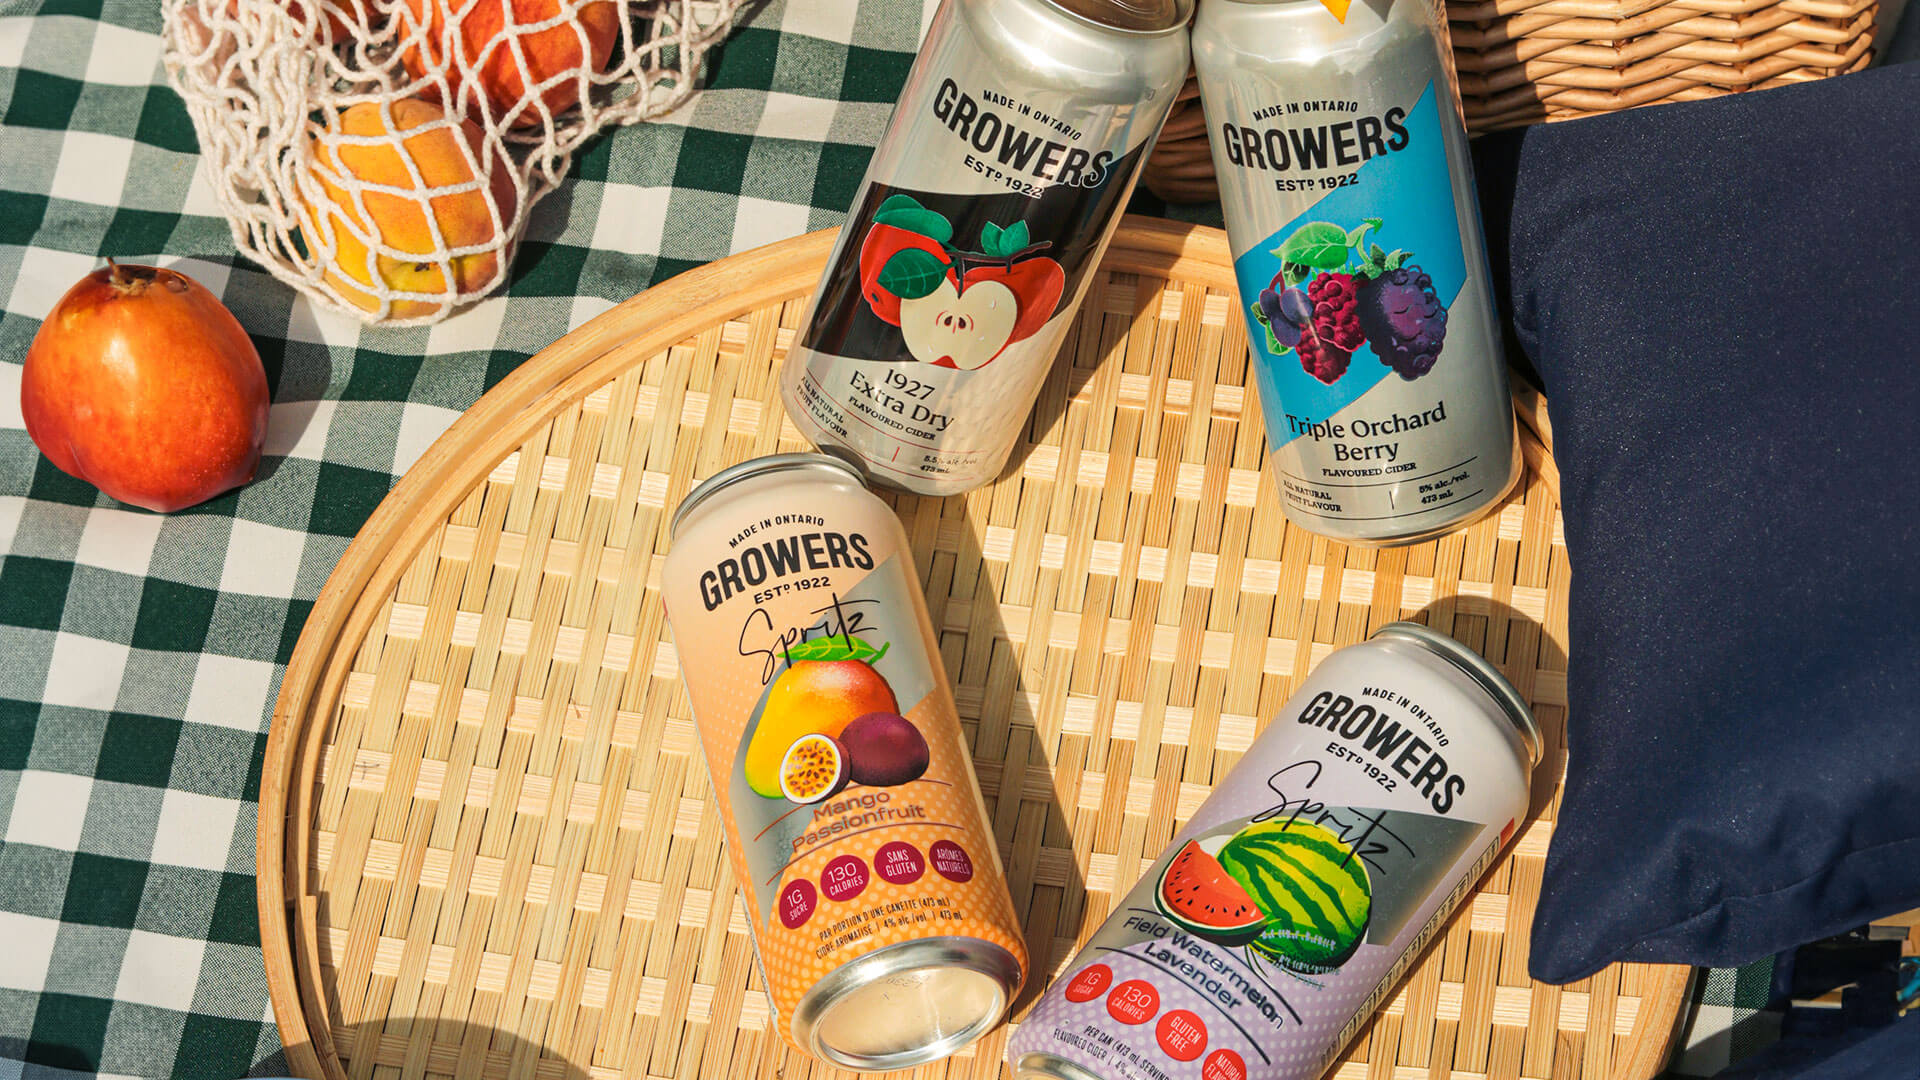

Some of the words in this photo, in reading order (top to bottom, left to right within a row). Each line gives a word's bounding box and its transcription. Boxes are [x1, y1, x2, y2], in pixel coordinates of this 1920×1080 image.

[983, 90, 1015, 110] MADE
[1017, 103, 1031, 117] IN
[1033, 110, 1082, 141] ONTARIO
[1253, 103, 1284, 122] MADE
[1287, 101, 1300, 113] IN
[1303, 100, 1358, 113] ONTARIO
[933, 77, 1113, 188] GROWERS
[1222, 106, 1410, 172] GROWERS
[1005, 176, 1045, 199] 1922
[1319, 172, 1359, 190] 1922
[884, 368, 935, 400] 1927
[810, 388, 844, 424] NATURAL
[850, 370, 906, 415] Extra
[910, 403, 955, 433] Dry
[811, 404, 848, 438] FLAVOUR
[849, 395, 904, 431] FLAVOURED
[905, 426, 937, 441] CIDER
[1285, 413, 1345, 441] Triple
[1351, 400, 1447, 438] Orchard
[1333, 442, 1399, 462] Berry
[1322, 468, 1383, 478] FLAVOURED
[1385, 462, 1417, 474] CIDER
[1294, 485, 1332, 500] NATURAL
[1419, 484, 1433, 494] 5%
[1421, 494, 1438, 504] 473
[1438, 489, 1454, 500] mL
[1302, 498, 1342, 512] FLAVOUR
[728, 524, 758, 549] MADE
[759, 518, 773, 530] IN
[775, 514, 825, 527] ONTARIO
[699, 532, 874, 612] GROWERS
[793, 576, 831, 592] 1922
[739, 592, 881, 686] Spritz
[1361, 687, 1396, 703] MADE
[1396, 695, 1410, 709] IN
[1409, 704, 1450, 748] ONTARIO
[1297, 691, 1465, 815] GROWERS
[1365, 762, 1398, 793] 1922
[813, 791, 891, 822] Mango
[1250, 759, 1416, 876] Spritz
[791, 804, 926, 853] Passionfruit
[885, 861, 917, 878] GLUTEN
[886, 849, 909, 864] SANS
[827, 862, 857, 884] 130
[829, 875, 864, 896] CALORIES
[787, 888, 804, 908] 1G
[789, 901, 808, 921] SUCRE
[815, 942, 835, 960] CIDRE
[883, 919, 897, 929] 4%
[939, 909, 953, 921] 473
[819, 930, 833, 942] PAR
[832, 914, 863, 934] PORTION
[885, 899, 917, 914] CANETTE
[1083, 972, 1102, 985] 1G
[1123, 916, 1170, 940] Field
[1170, 930, 1285, 1030] Watermelon
[1143, 941, 1243, 1010] Lavender
[1111, 996, 1145, 1021] CALORIES
[1122, 985, 1152, 1008] 130
[1053, 1028, 1088, 1050] FLAVOURED
[1086, 1042, 1108, 1061] CIDER
[1083, 1025, 1101, 1039] PER
[1097, 1032, 1115, 1046] CAN
[1111, 1040, 1132, 1057] (473
[1127, 1053, 1141, 1065] mL
[1165, 1030, 1190, 1054] FREE
[1169, 1014, 1202, 1045] GLUTEN
